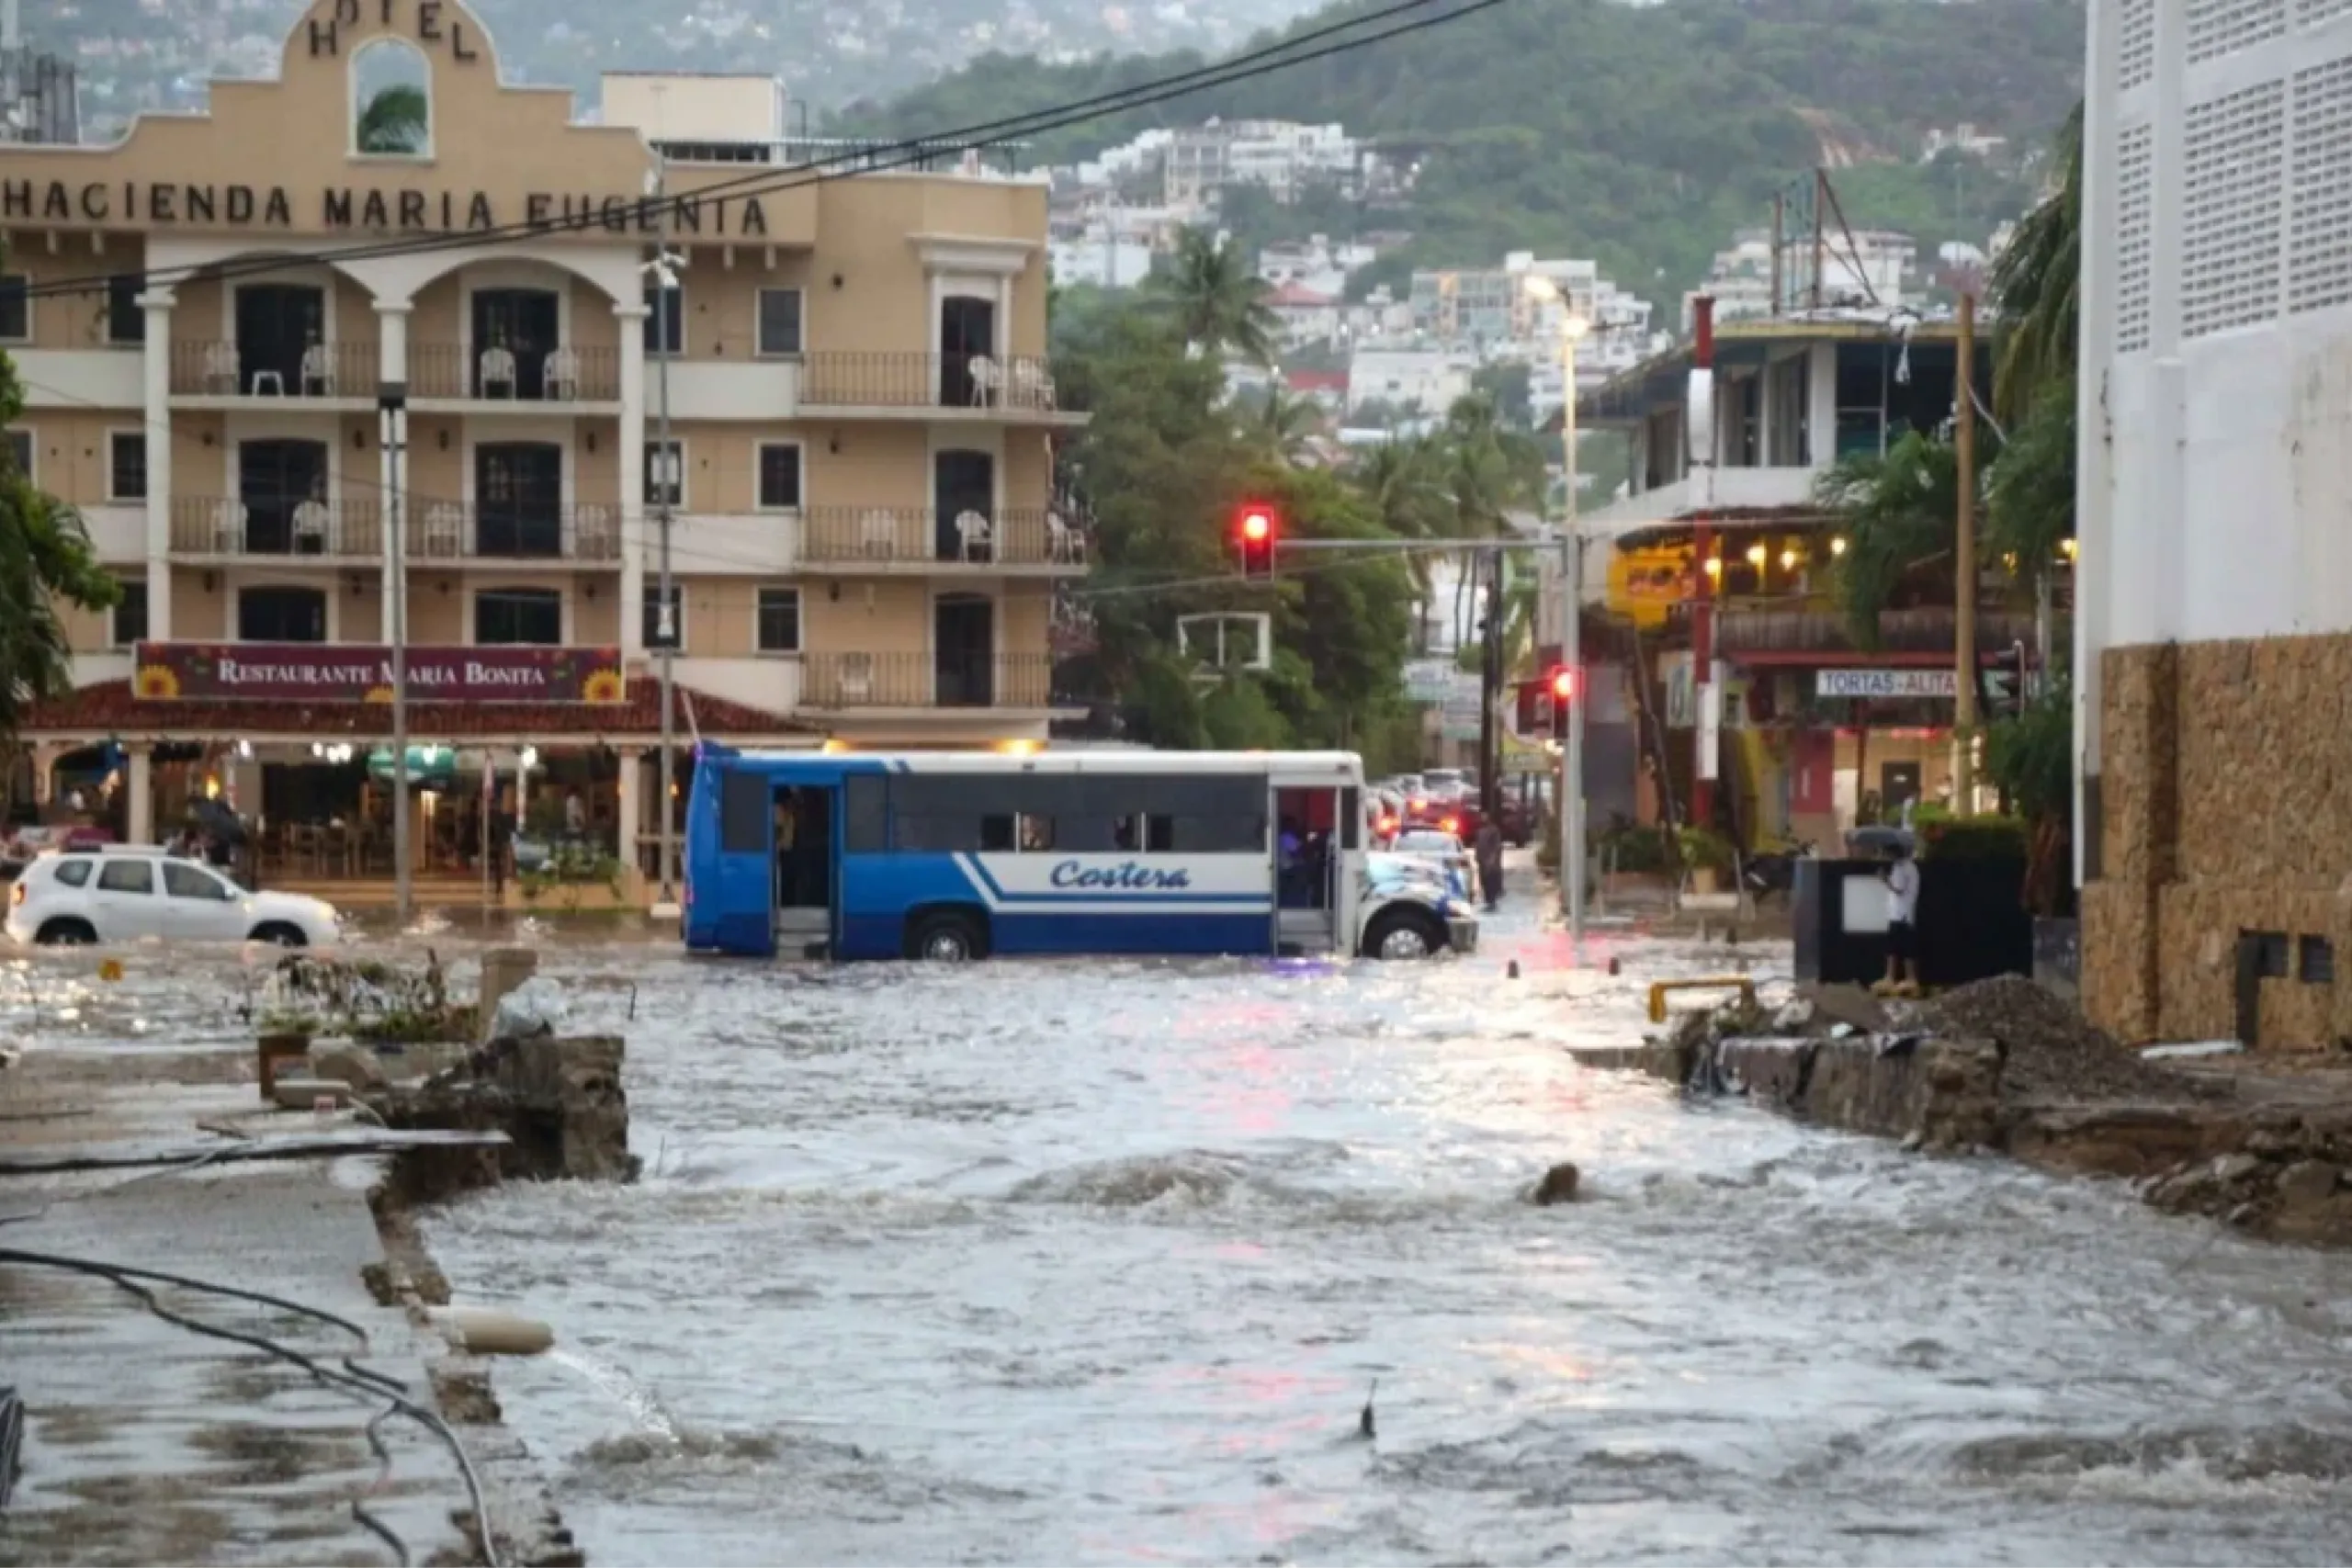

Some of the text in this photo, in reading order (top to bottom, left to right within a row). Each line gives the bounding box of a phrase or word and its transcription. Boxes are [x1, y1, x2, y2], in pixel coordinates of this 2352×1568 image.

[4, 179, 767, 235] HACIENDA MARIA EUGENIA
[1050, 860, 1191, 888] Costera
